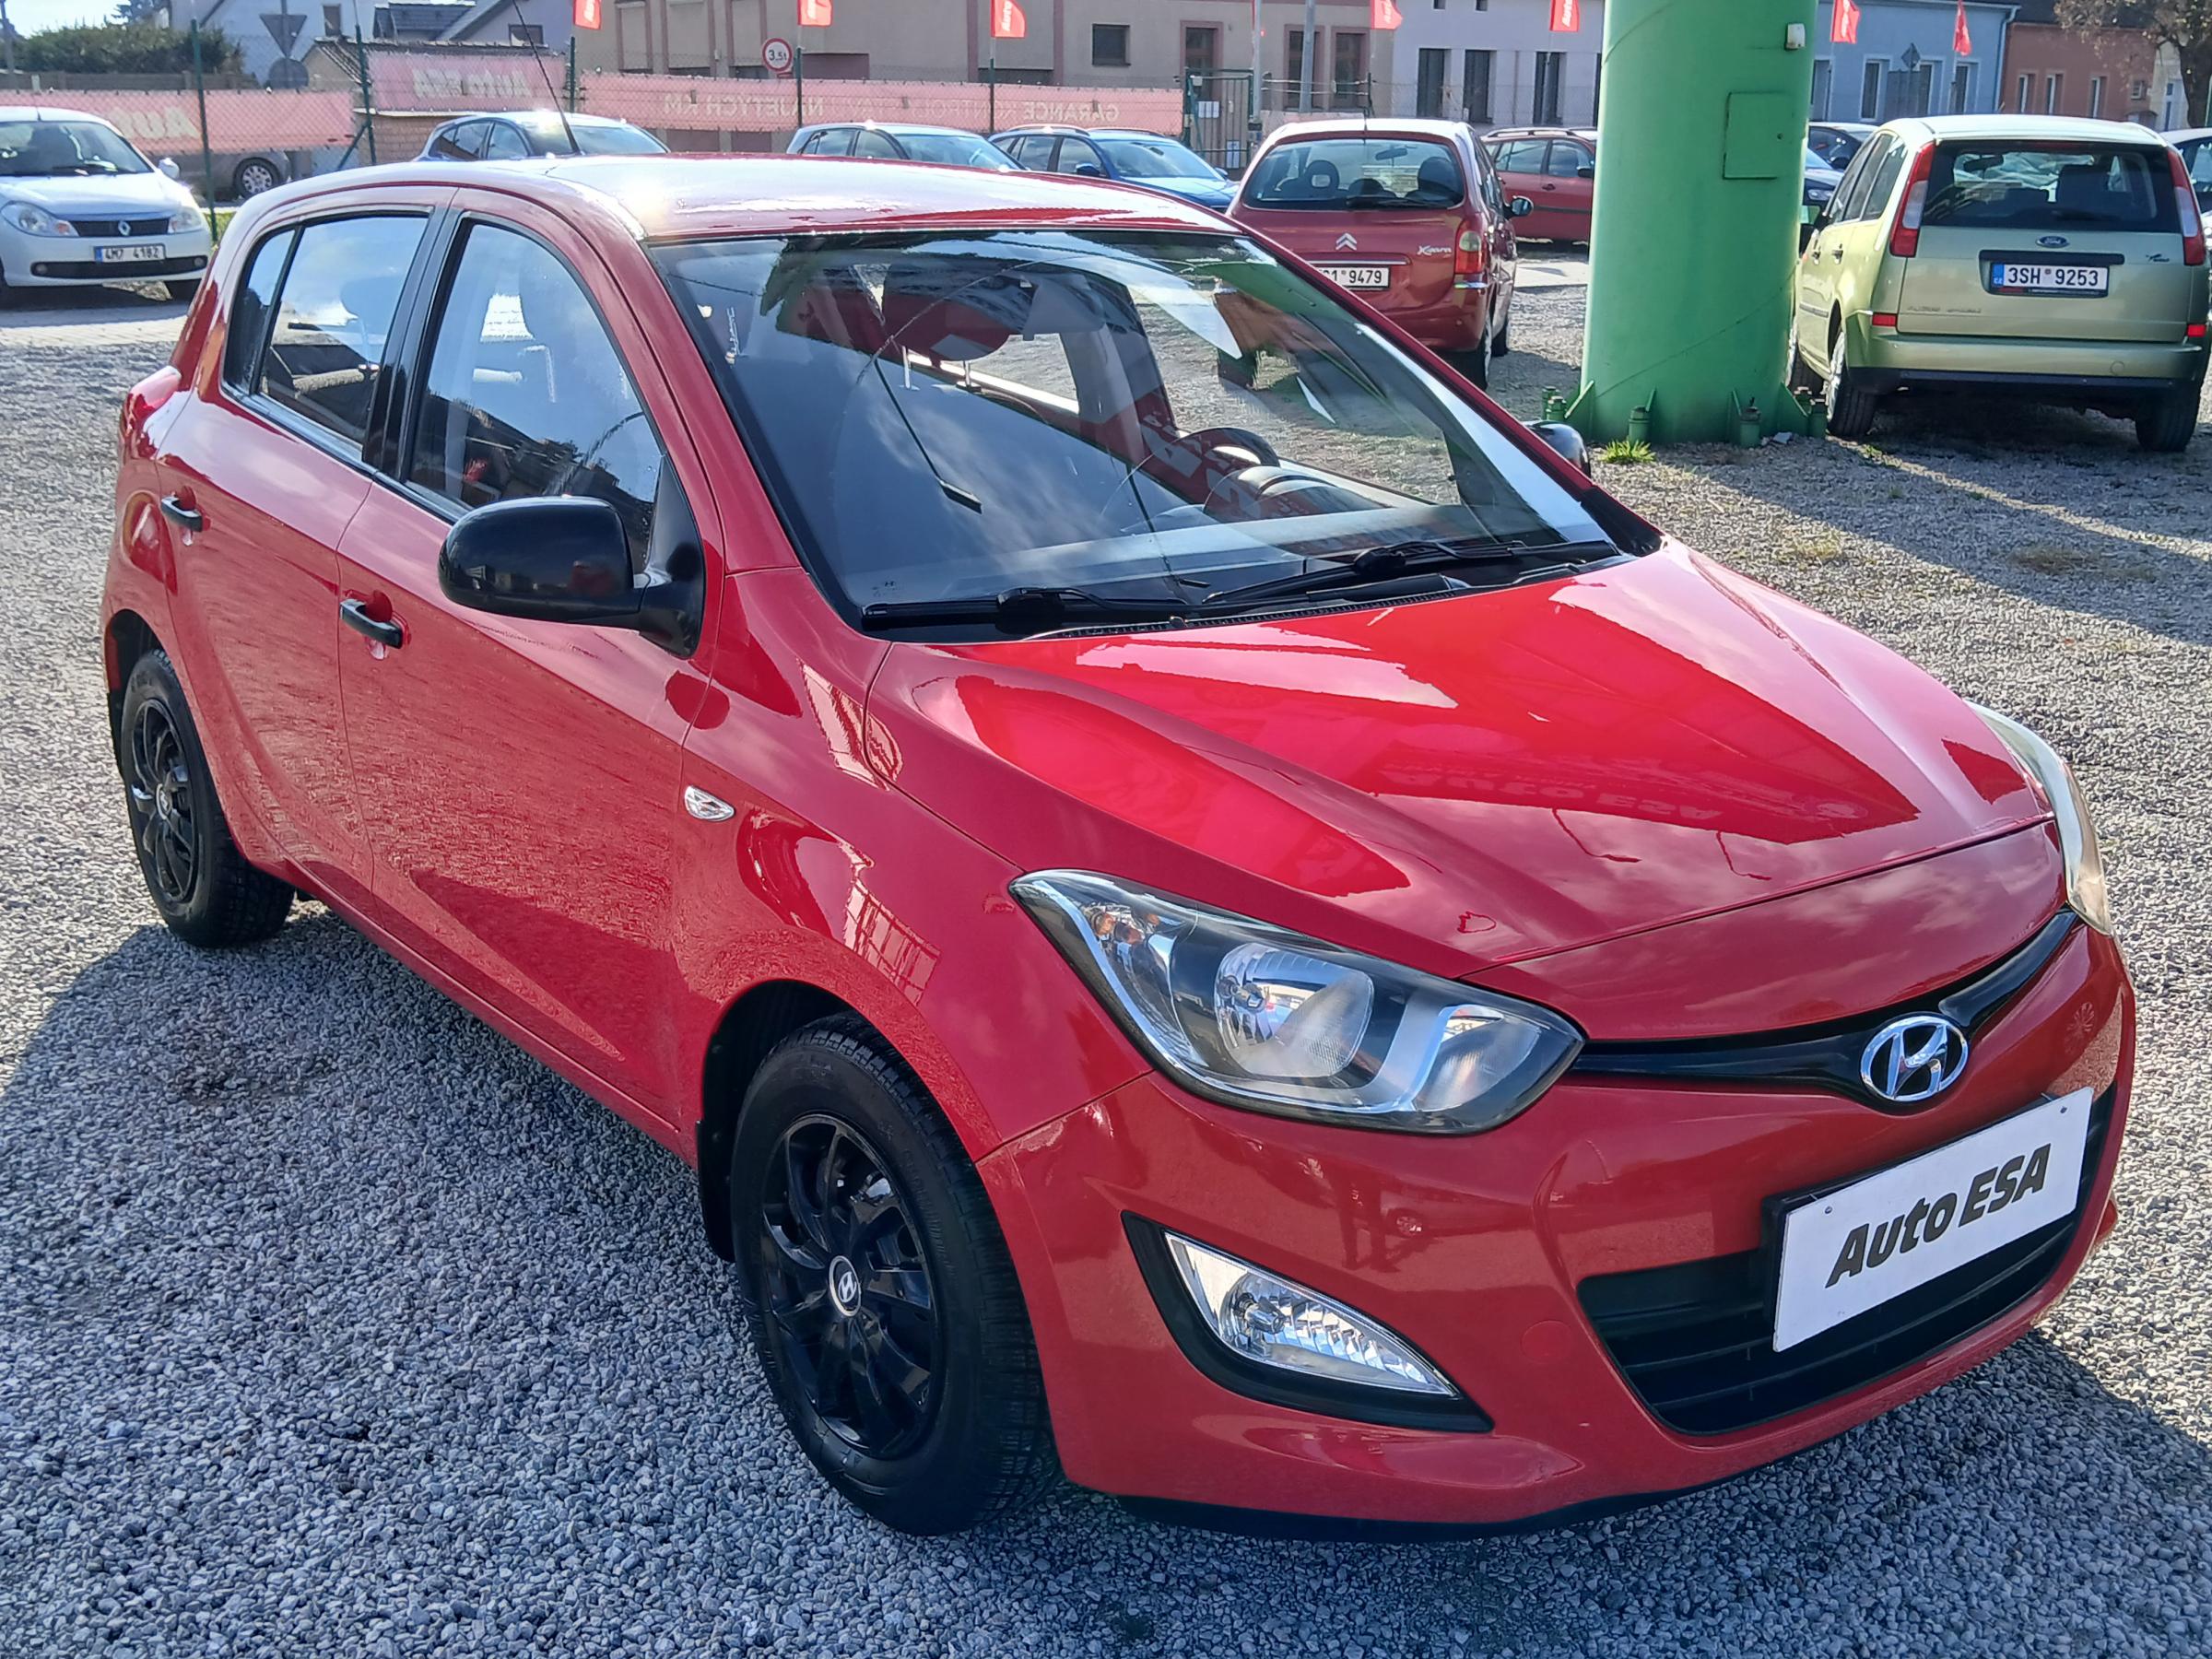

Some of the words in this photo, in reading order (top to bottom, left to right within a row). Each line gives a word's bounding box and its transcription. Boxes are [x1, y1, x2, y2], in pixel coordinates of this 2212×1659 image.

[1348, 269, 1382, 284] 9479
[2007, 266, 2041, 285] 3SH
[2054, 268, 2099, 287] 9253
[1825, 1192, 1958, 1288] Auto
[1959, 1142, 2052, 1228] ESA
